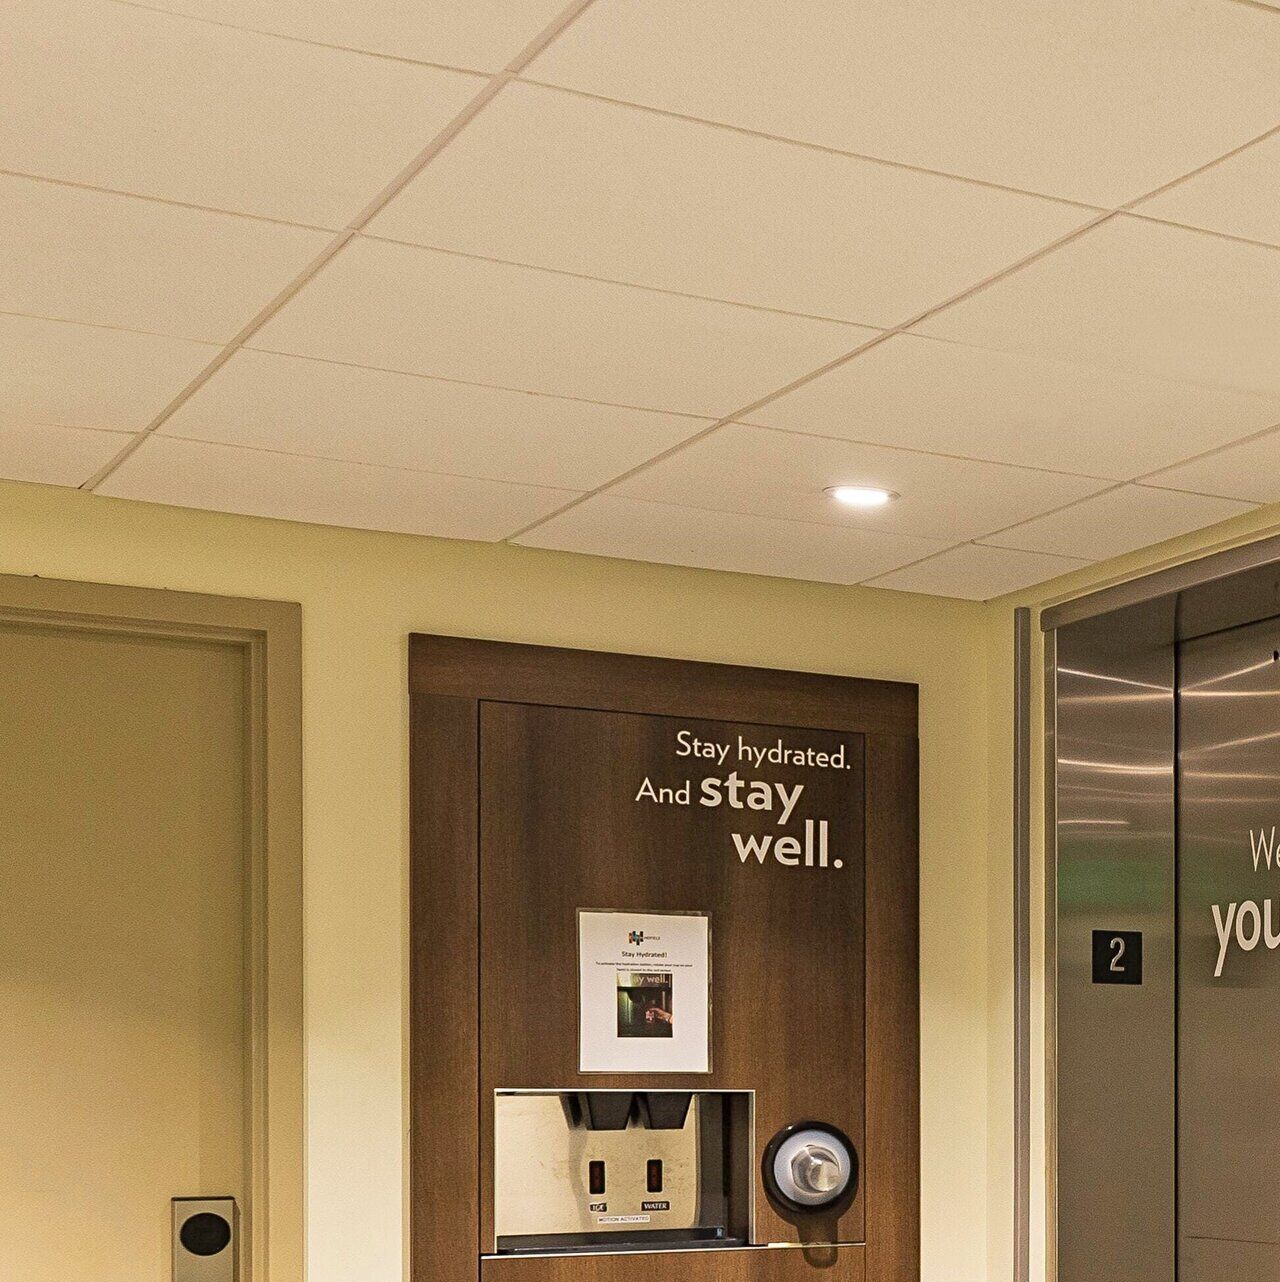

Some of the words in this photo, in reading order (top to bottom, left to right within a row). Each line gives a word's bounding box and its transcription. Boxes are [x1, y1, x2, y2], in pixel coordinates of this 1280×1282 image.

[675, 730, 730, 765] Stay
[738, 736, 851, 769] hydrated.
[635, 777, 690, 805] And
[700, 771, 804, 825] stay
[731, 819, 843, 868] well.
[621, 951, 635, 959] Stay
[1109, 937, 1126, 972] 2
[643, 1202, 667, 1210] WATER
